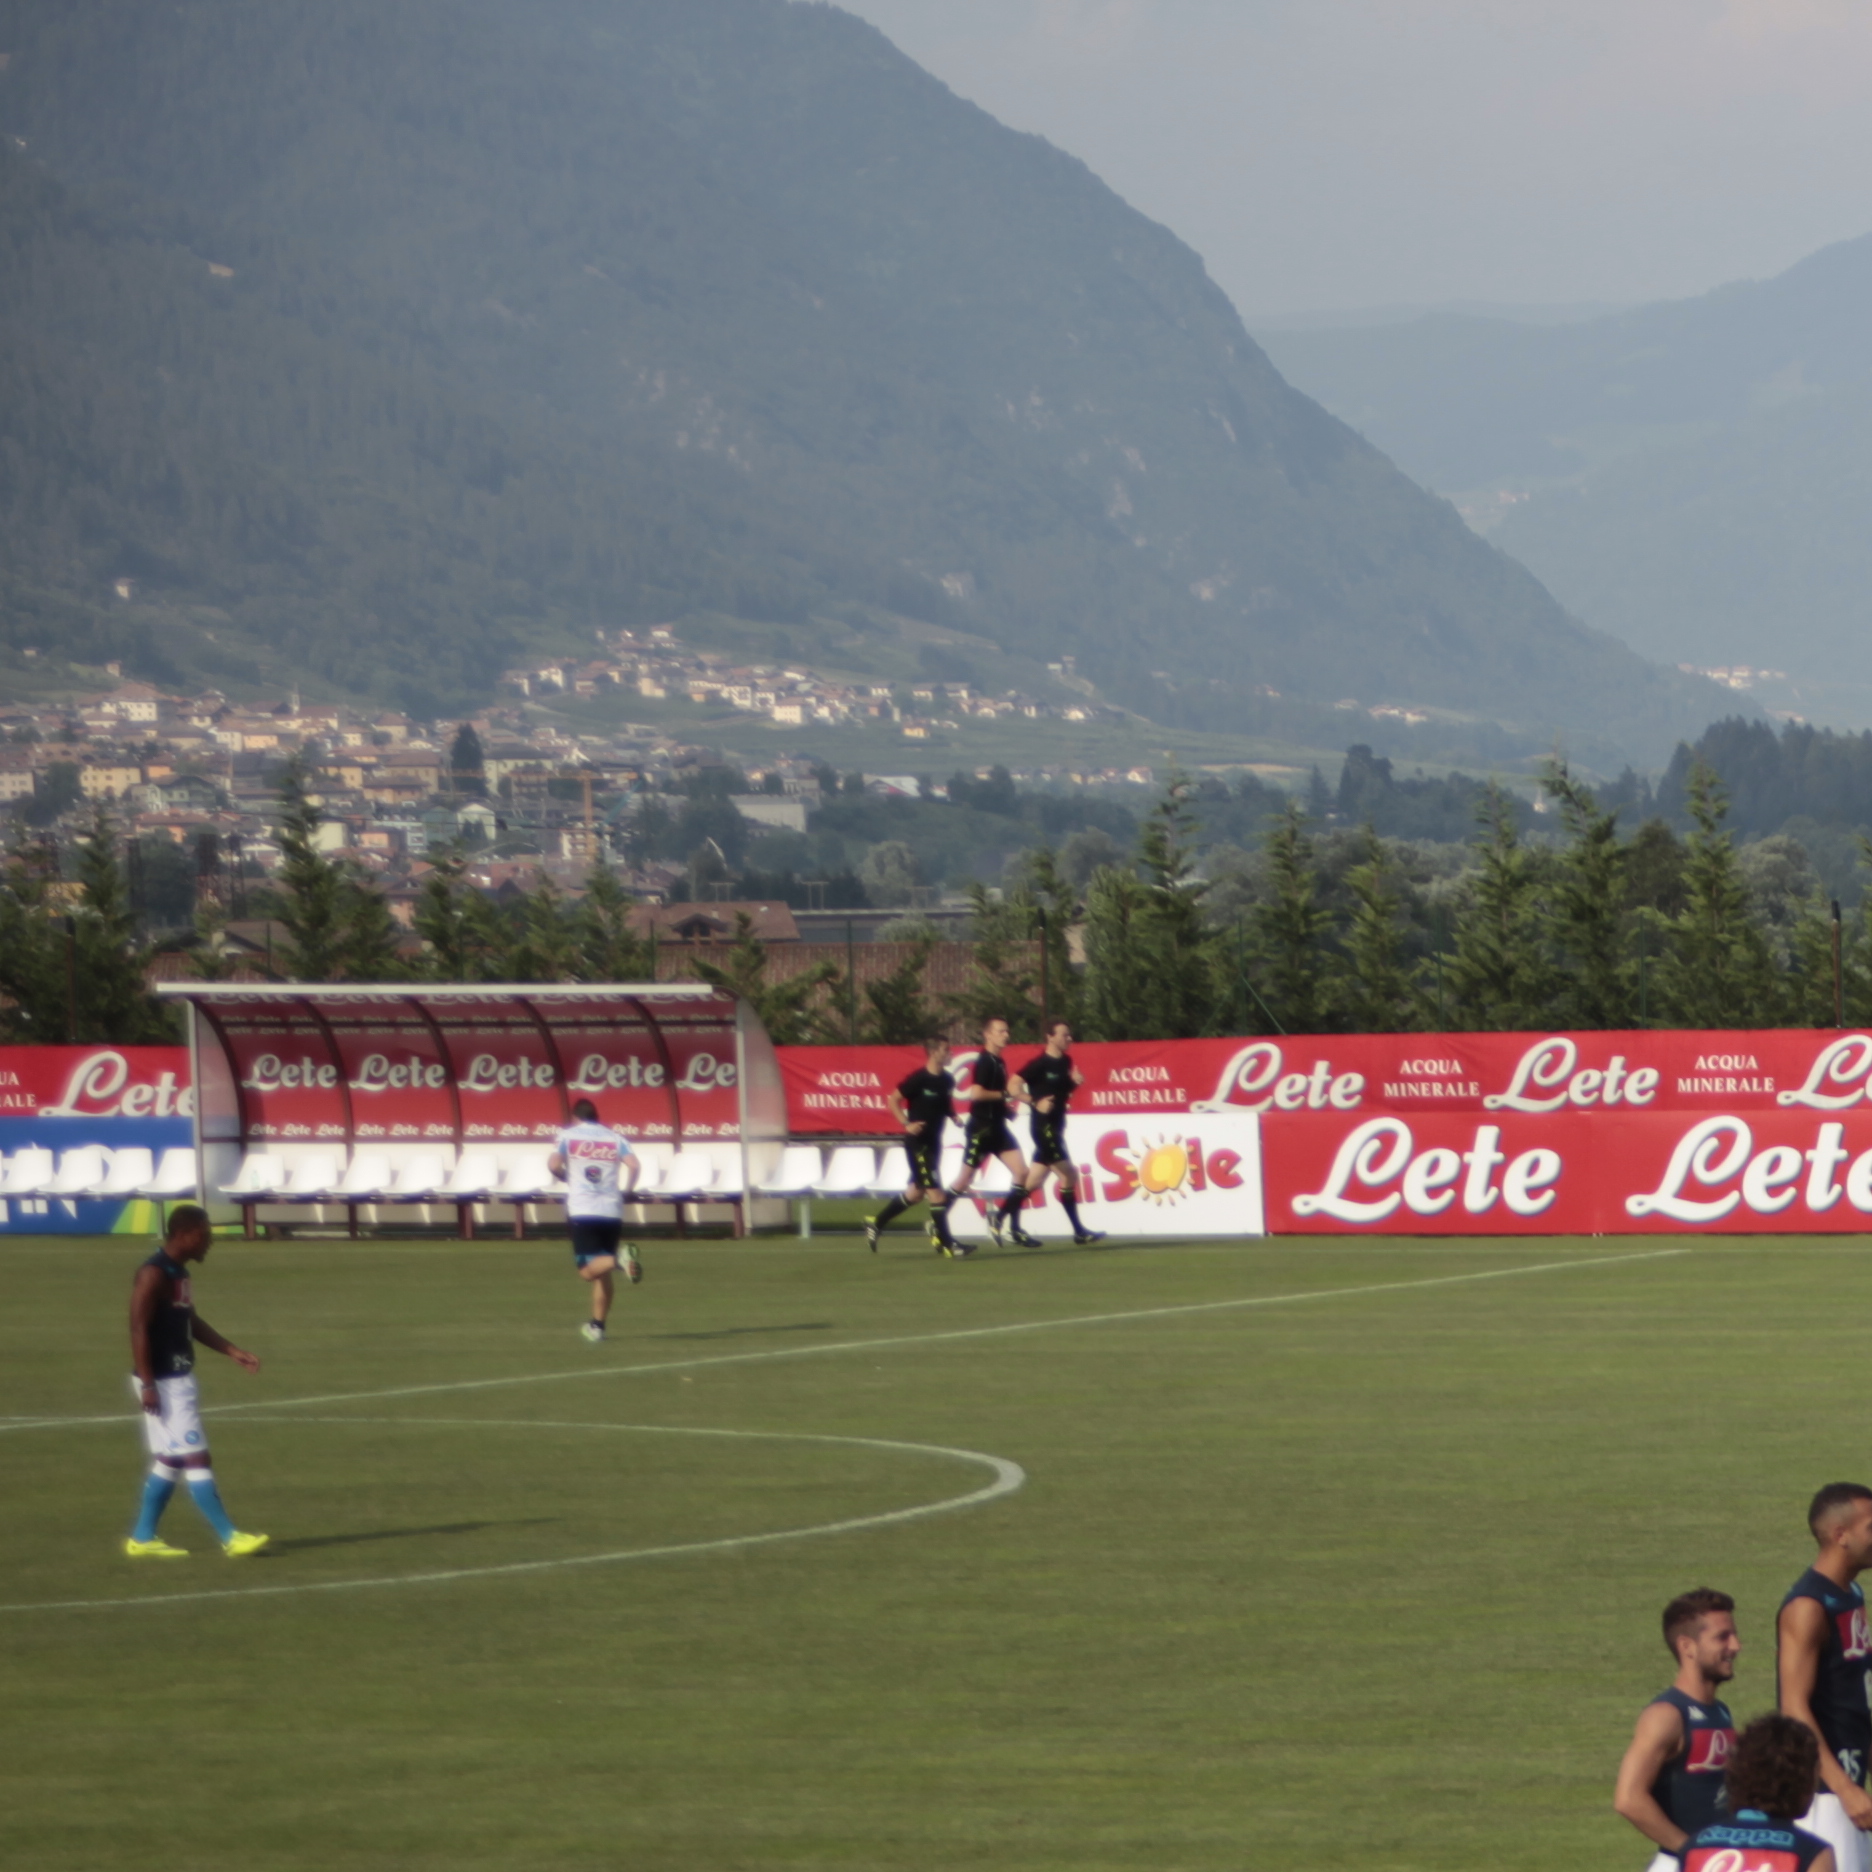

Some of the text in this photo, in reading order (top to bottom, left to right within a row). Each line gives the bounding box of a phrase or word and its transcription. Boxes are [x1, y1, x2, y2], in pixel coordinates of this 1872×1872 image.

[1400, 1059, 1463, 1076] ACQUA
[1694, 1054, 1759, 1071] ACQUA
[241, 1053, 338, 1091] Lete
[348, 1053, 446, 1091] Lete
[457, 1053, 555, 1091] Lete
[566, 1053, 665, 1092] Lete
[819, 1072, 881, 1088] ACQUA
[1108, 1066, 1170, 1083] ACQUA
[1189, 1041, 1364, 1113] Lete
[1483, 1037, 1659, 1112] Lete
[1384, 1081, 1480, 1098] MINERALE
[1678, 1076, 1775, 1094] MINERALE
[1092, 1087, 1186, 1107] MINERALE
[1291, 1116, 1562, 1222] Lete
